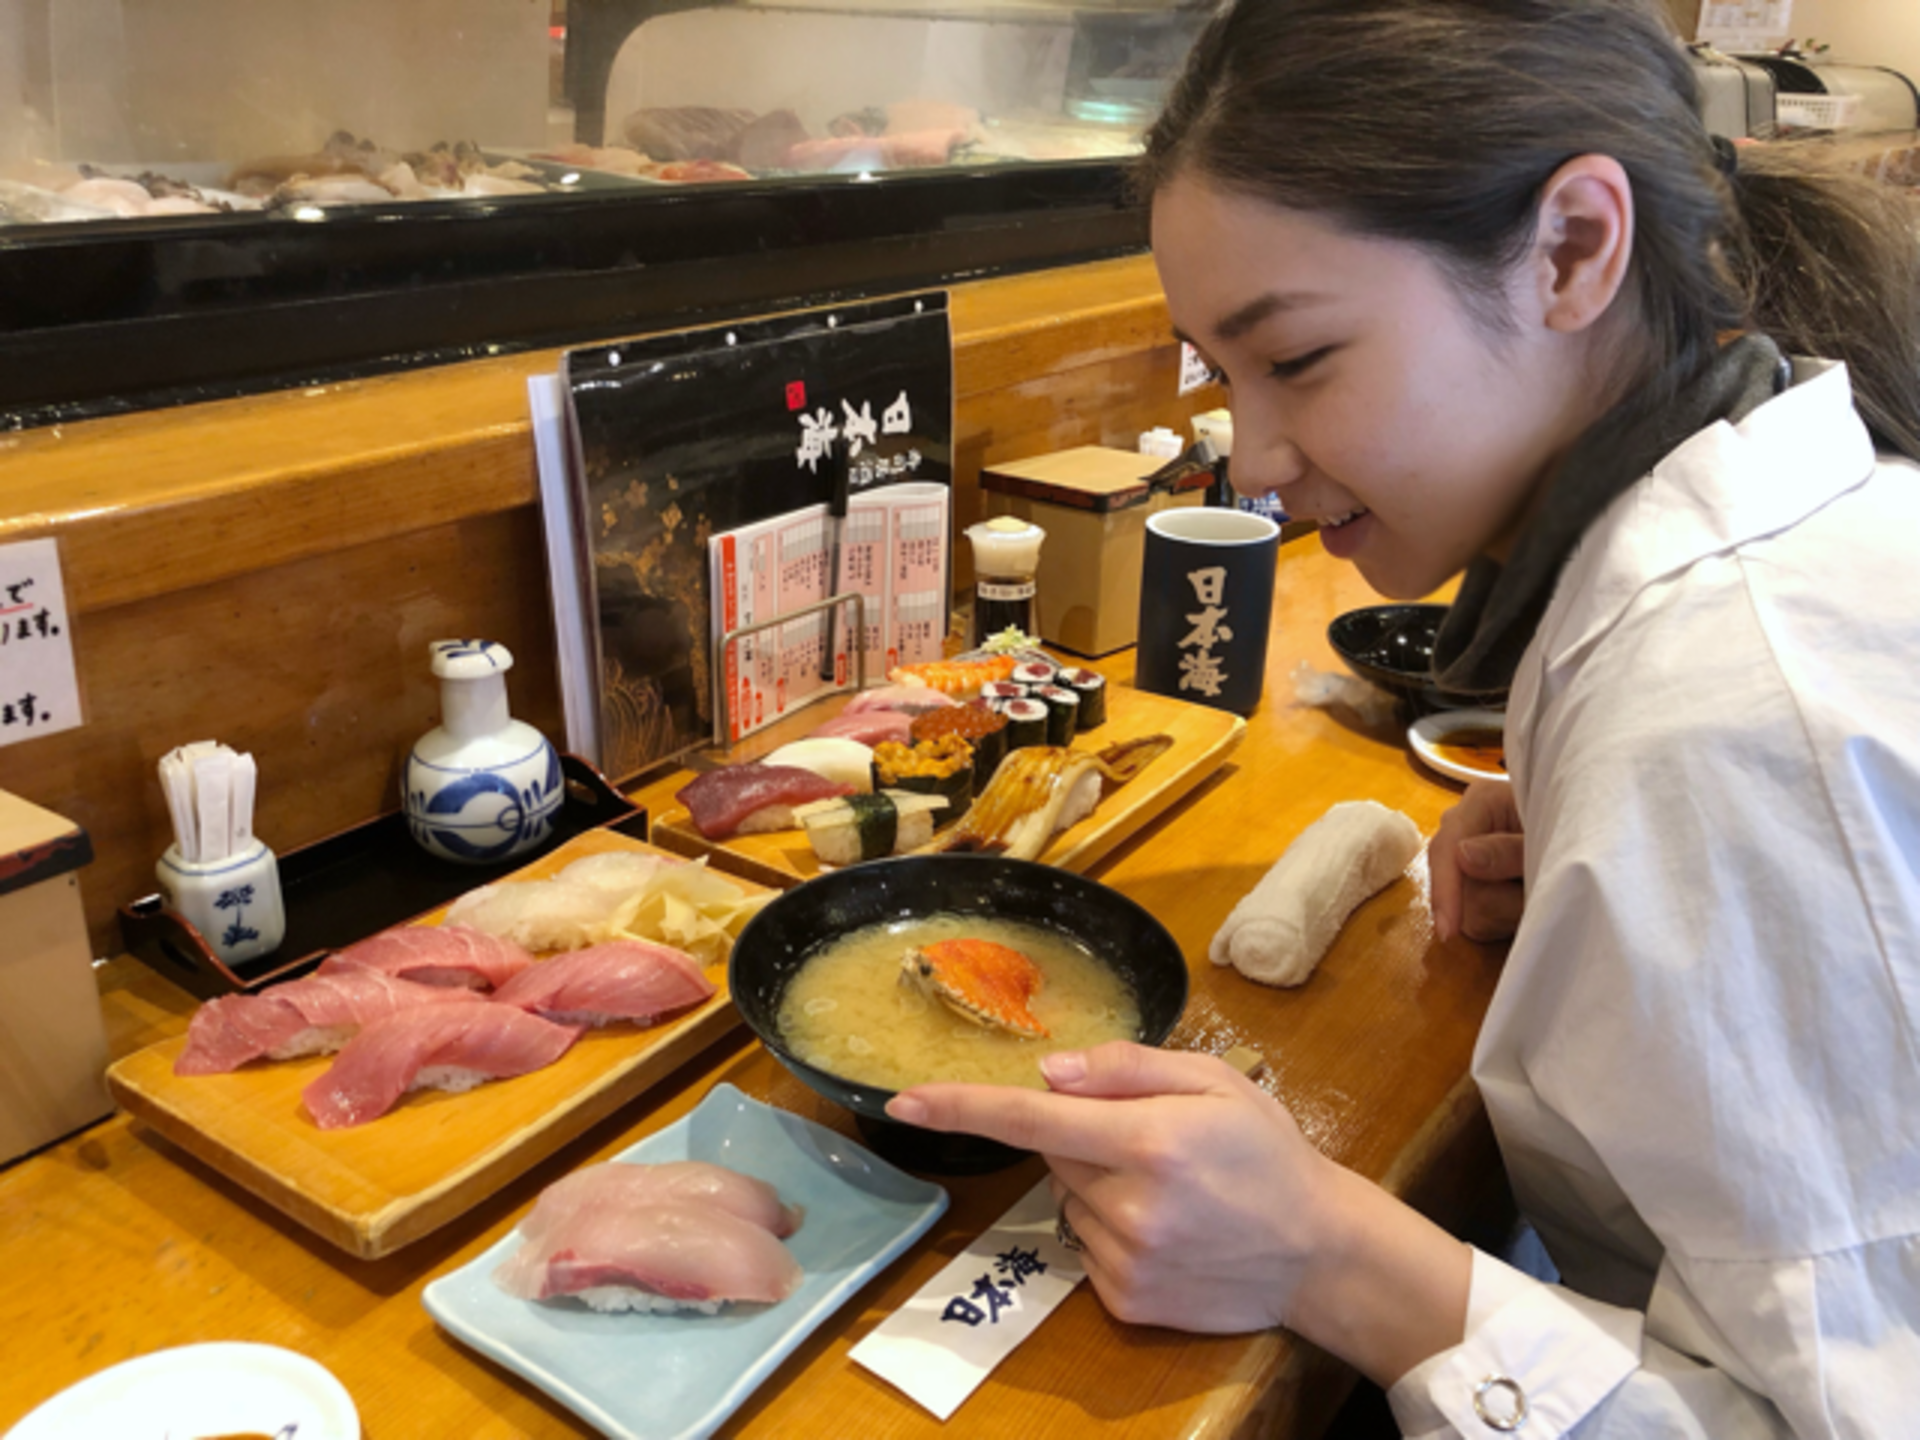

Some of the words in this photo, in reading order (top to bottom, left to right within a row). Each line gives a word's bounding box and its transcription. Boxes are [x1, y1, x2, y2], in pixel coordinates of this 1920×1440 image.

[797, 389, 912, 475] 日本海
[1176, 566, 1234, 697] 日本海
[940, 1245, 1048, 1327] 日本海
